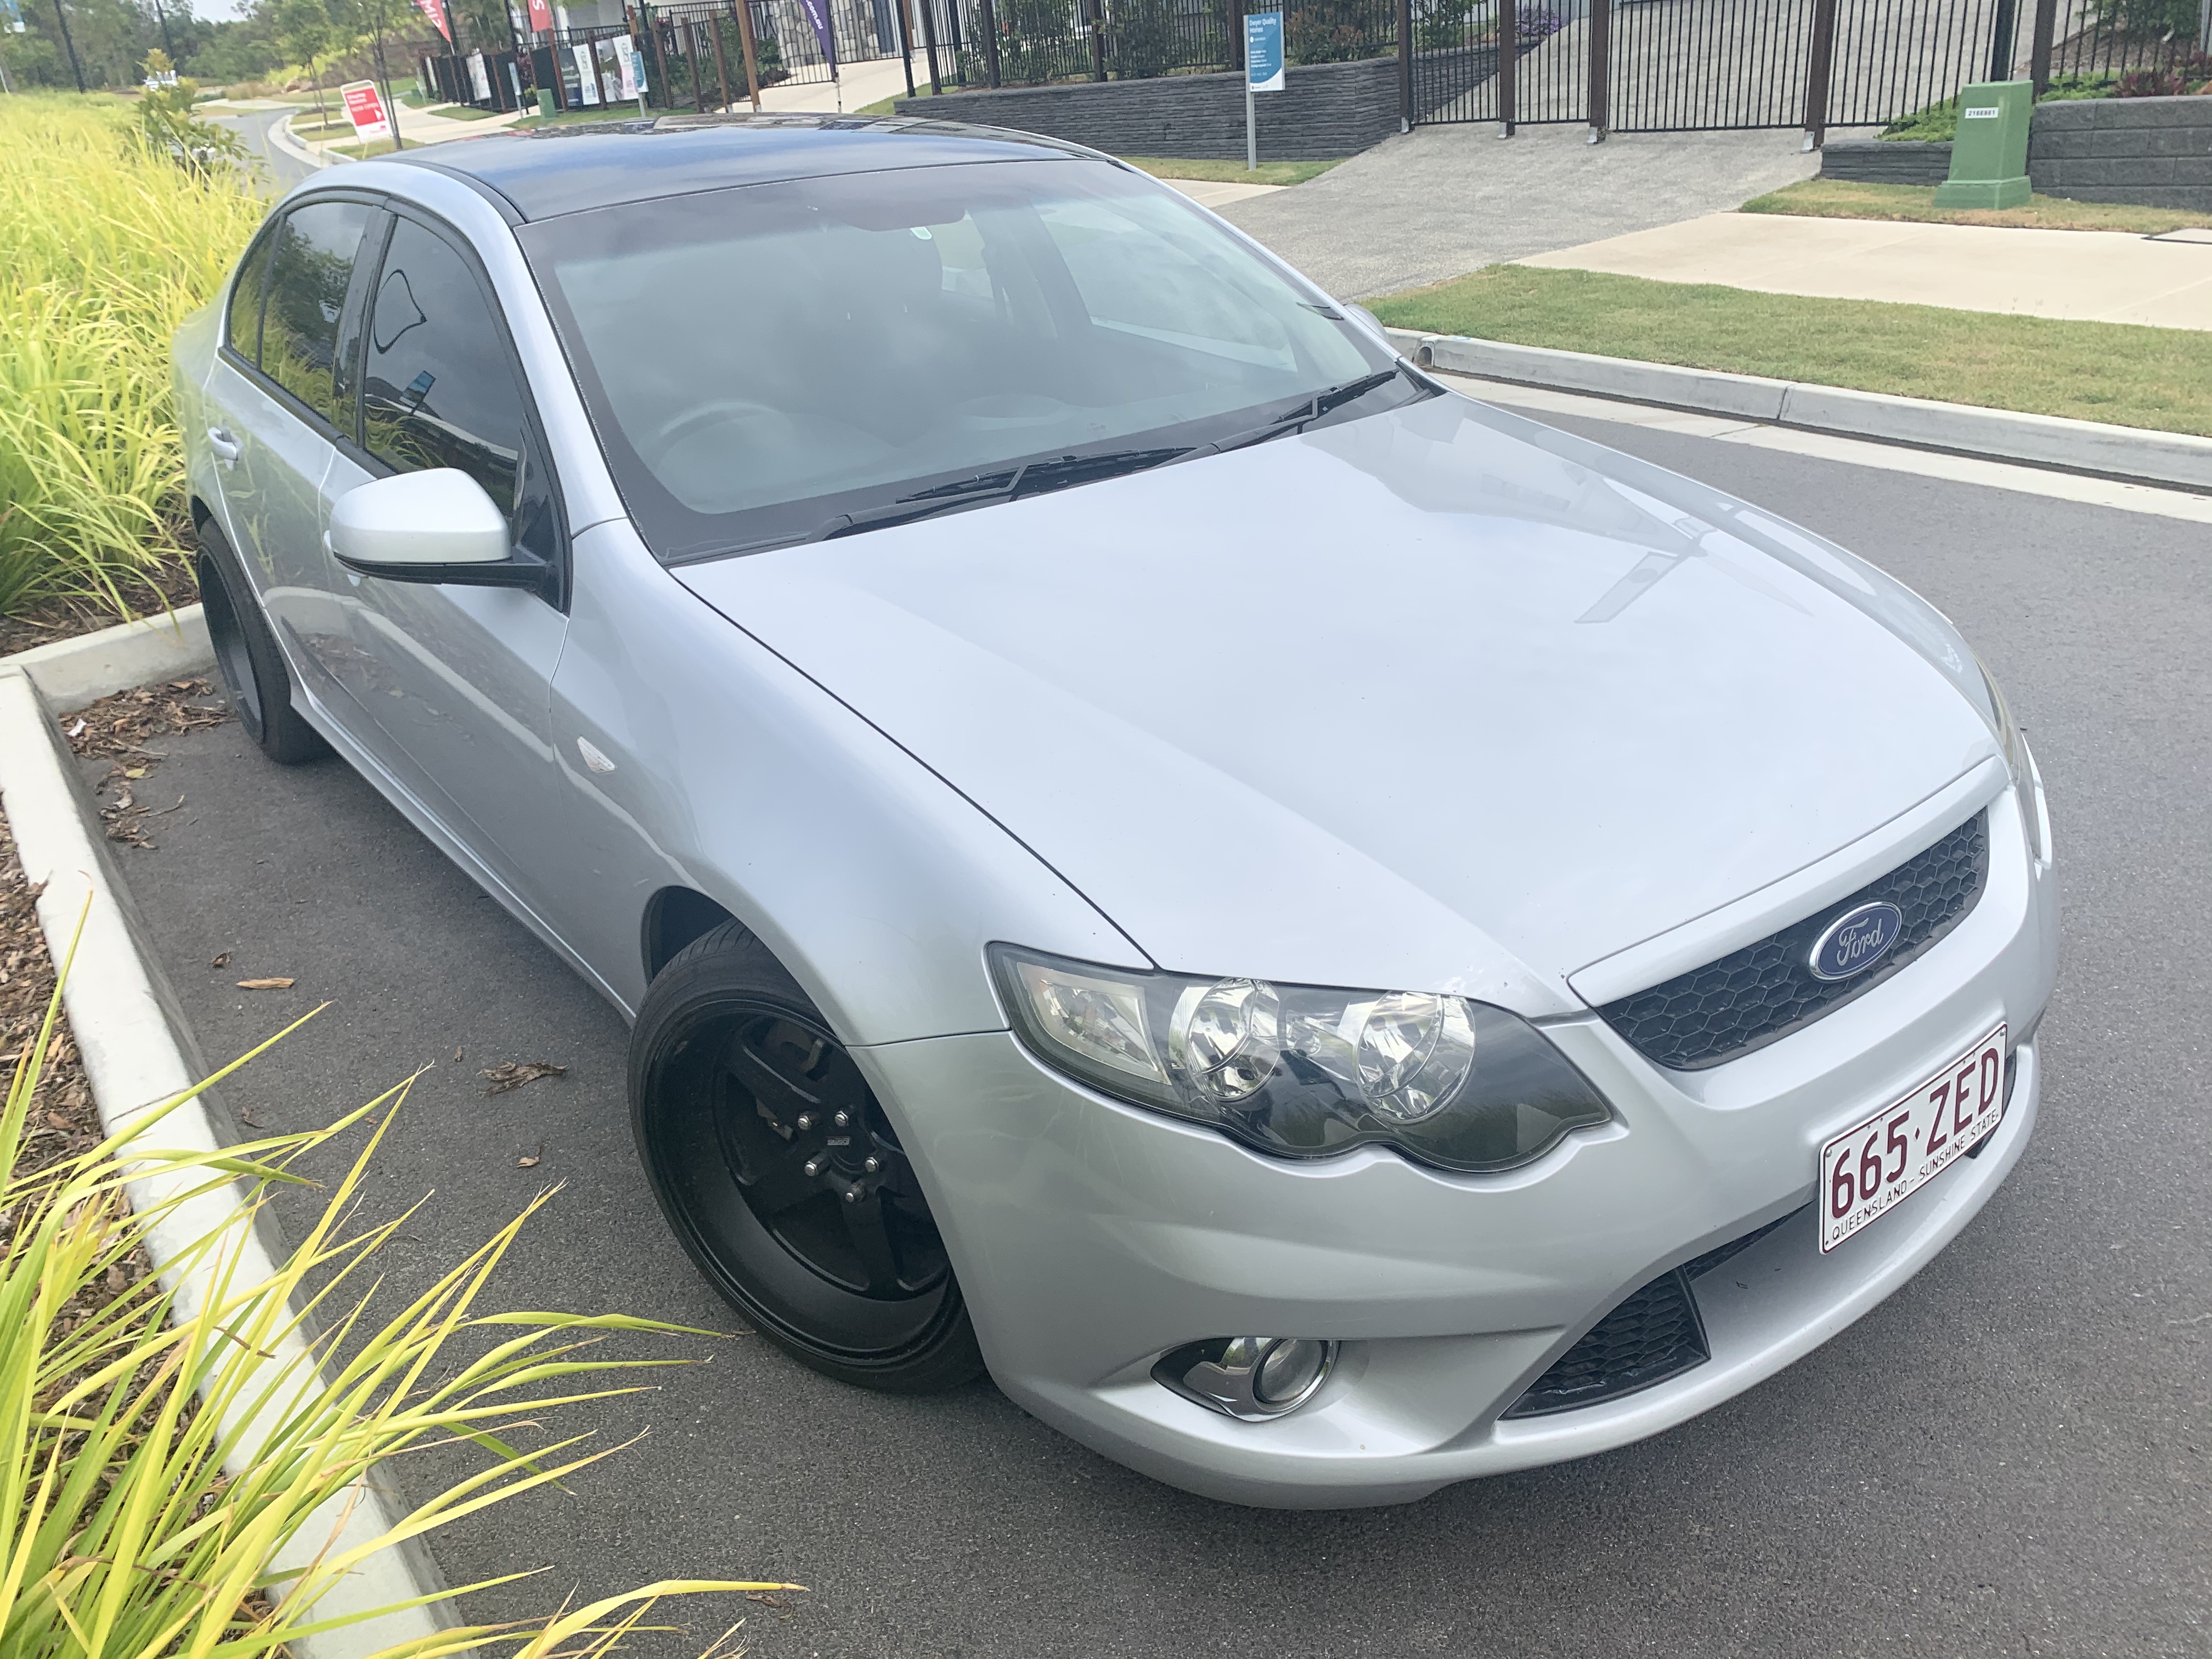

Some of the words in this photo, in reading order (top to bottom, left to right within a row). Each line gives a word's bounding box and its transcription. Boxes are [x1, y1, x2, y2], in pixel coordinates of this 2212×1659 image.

[1262, 17, 1277, 26] Quality
[1837, 917, 1884, 966] Ford
[1832, 1180, 1907, 1241] QUEENSLAND
[1920, 1134, 1965, 1181] SUNSHINE
[1970, 1108, 1997, 1142] STATE
